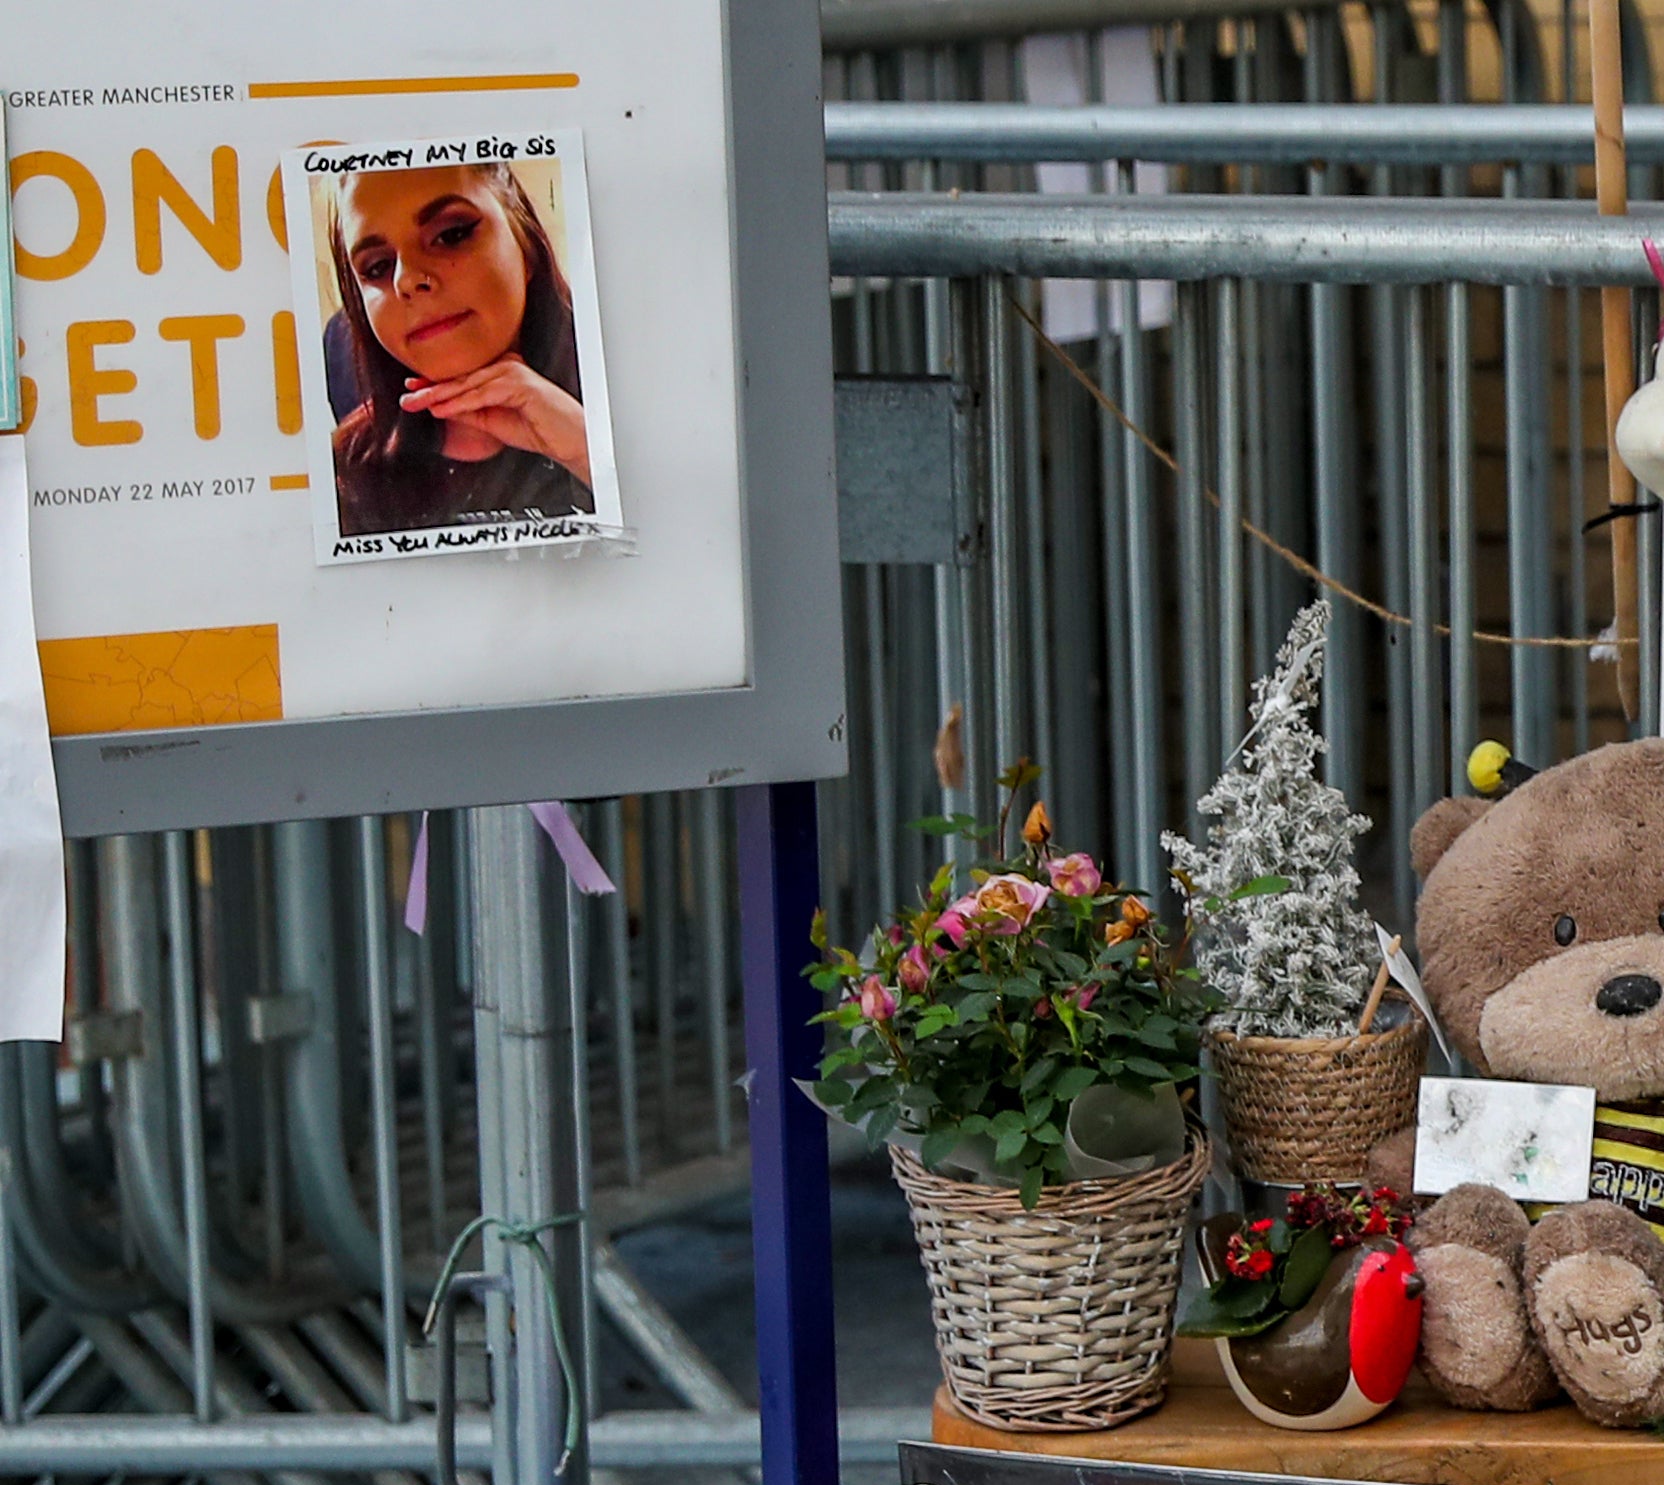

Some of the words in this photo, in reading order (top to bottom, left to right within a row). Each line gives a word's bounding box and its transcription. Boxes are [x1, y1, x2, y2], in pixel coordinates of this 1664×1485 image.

[9, 90, 94, 108] GREATER
[103, 85, 235, 105] MANCHESTER
[304, 147, 413, 174] COURTNEY
[426, 143, 467, 164] MY
[34, 486, 122, 507] MONDAY
[130, 483, 154, 502] 22
[161, 480, 205, 500] MAY
[212, 477, 256, 497] 2017
[435, 524, 510, 551] ALWAYS
[1562, 1311, 1654, 1357] Hugs
